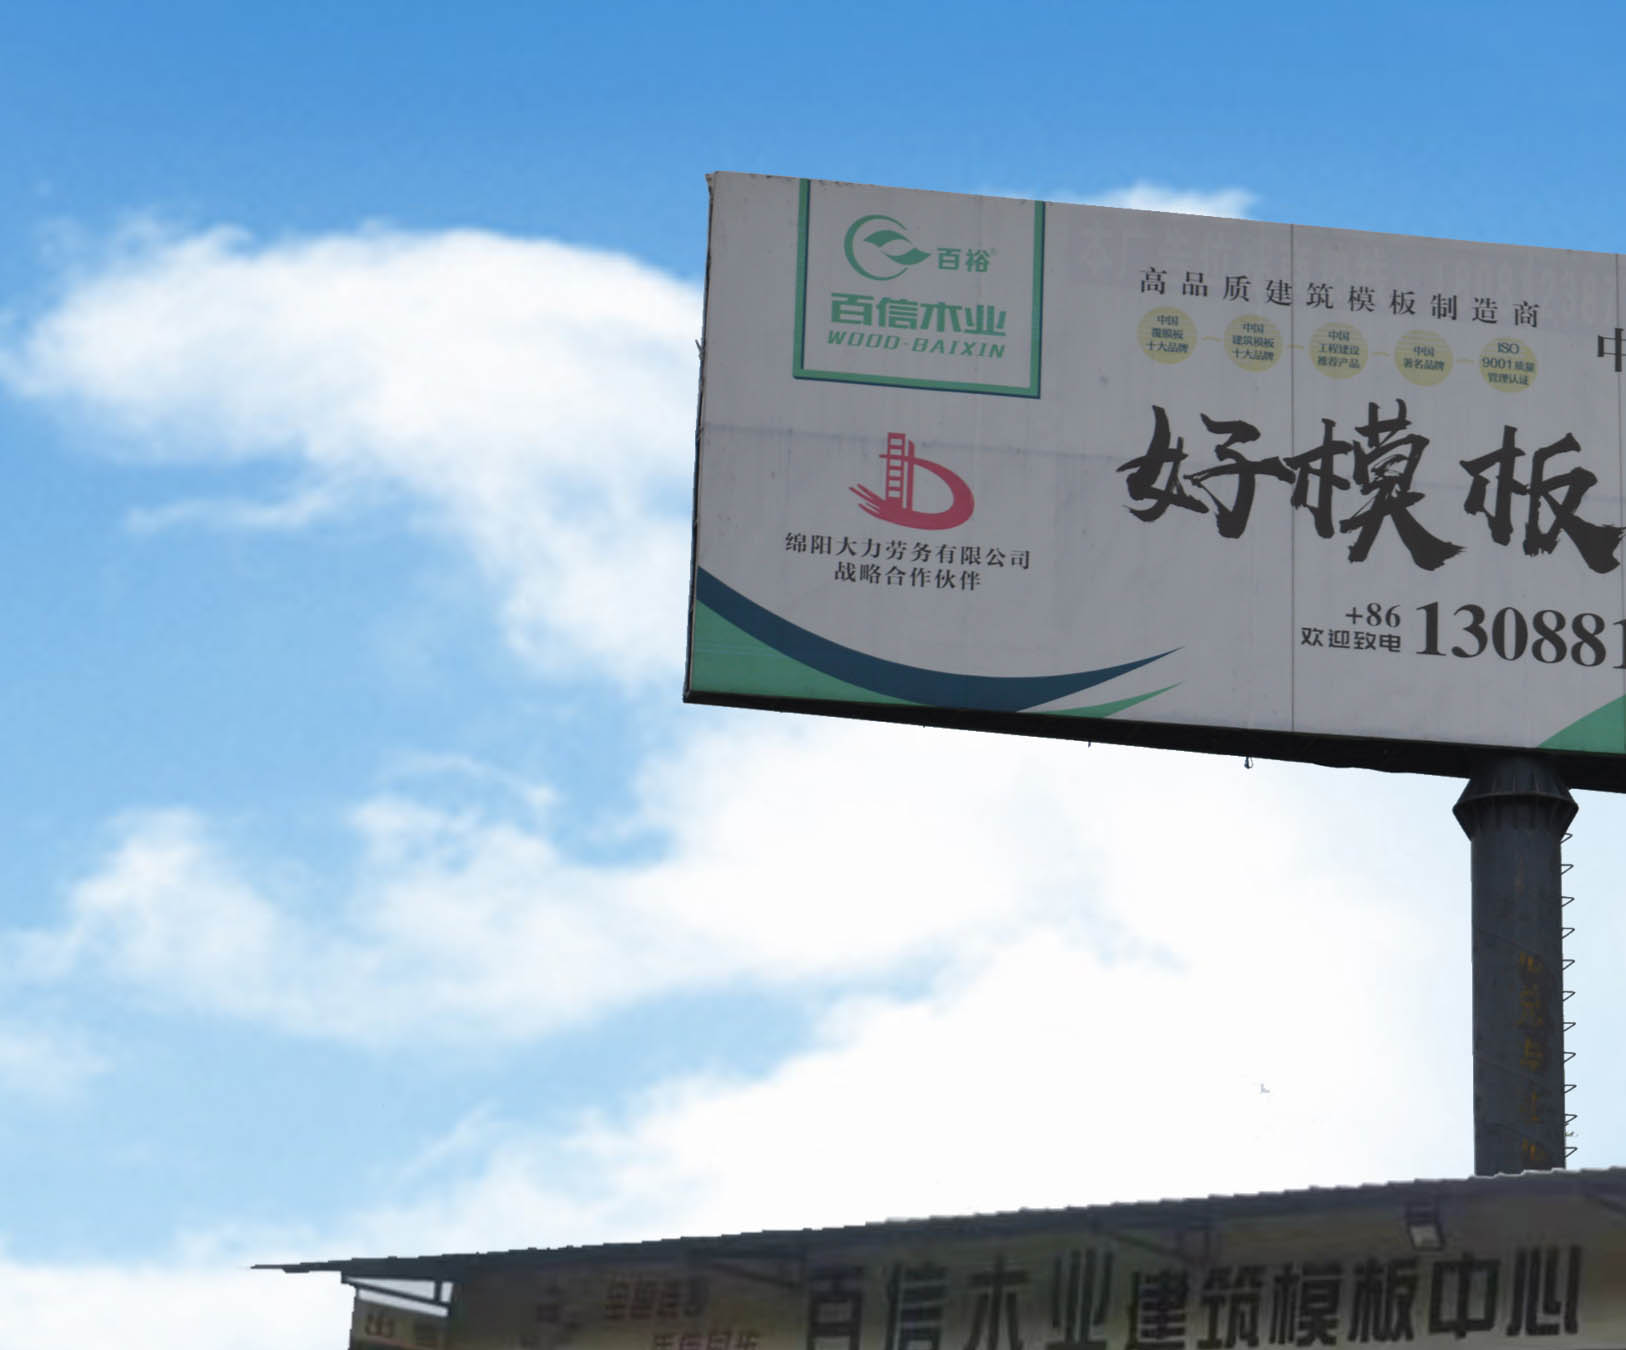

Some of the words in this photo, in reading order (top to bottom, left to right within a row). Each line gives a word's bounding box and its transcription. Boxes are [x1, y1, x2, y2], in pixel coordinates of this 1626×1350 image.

[937, 248, 992, 272] 百裕
[1139, 266, 1541, 329] 高品质建筑模板制造商
[830, 292, 1007, 336] 百信木业
[1497, 341, 1520, 355] ISO
[784, 532, 1031, 570] 绵阳大力劳务有限公司
[834, 560, 982, 592] 战略合作伙伴
[1344, 602, 1401, 629] +86
[1300, 626, 1401, 653] 欢迎致电
